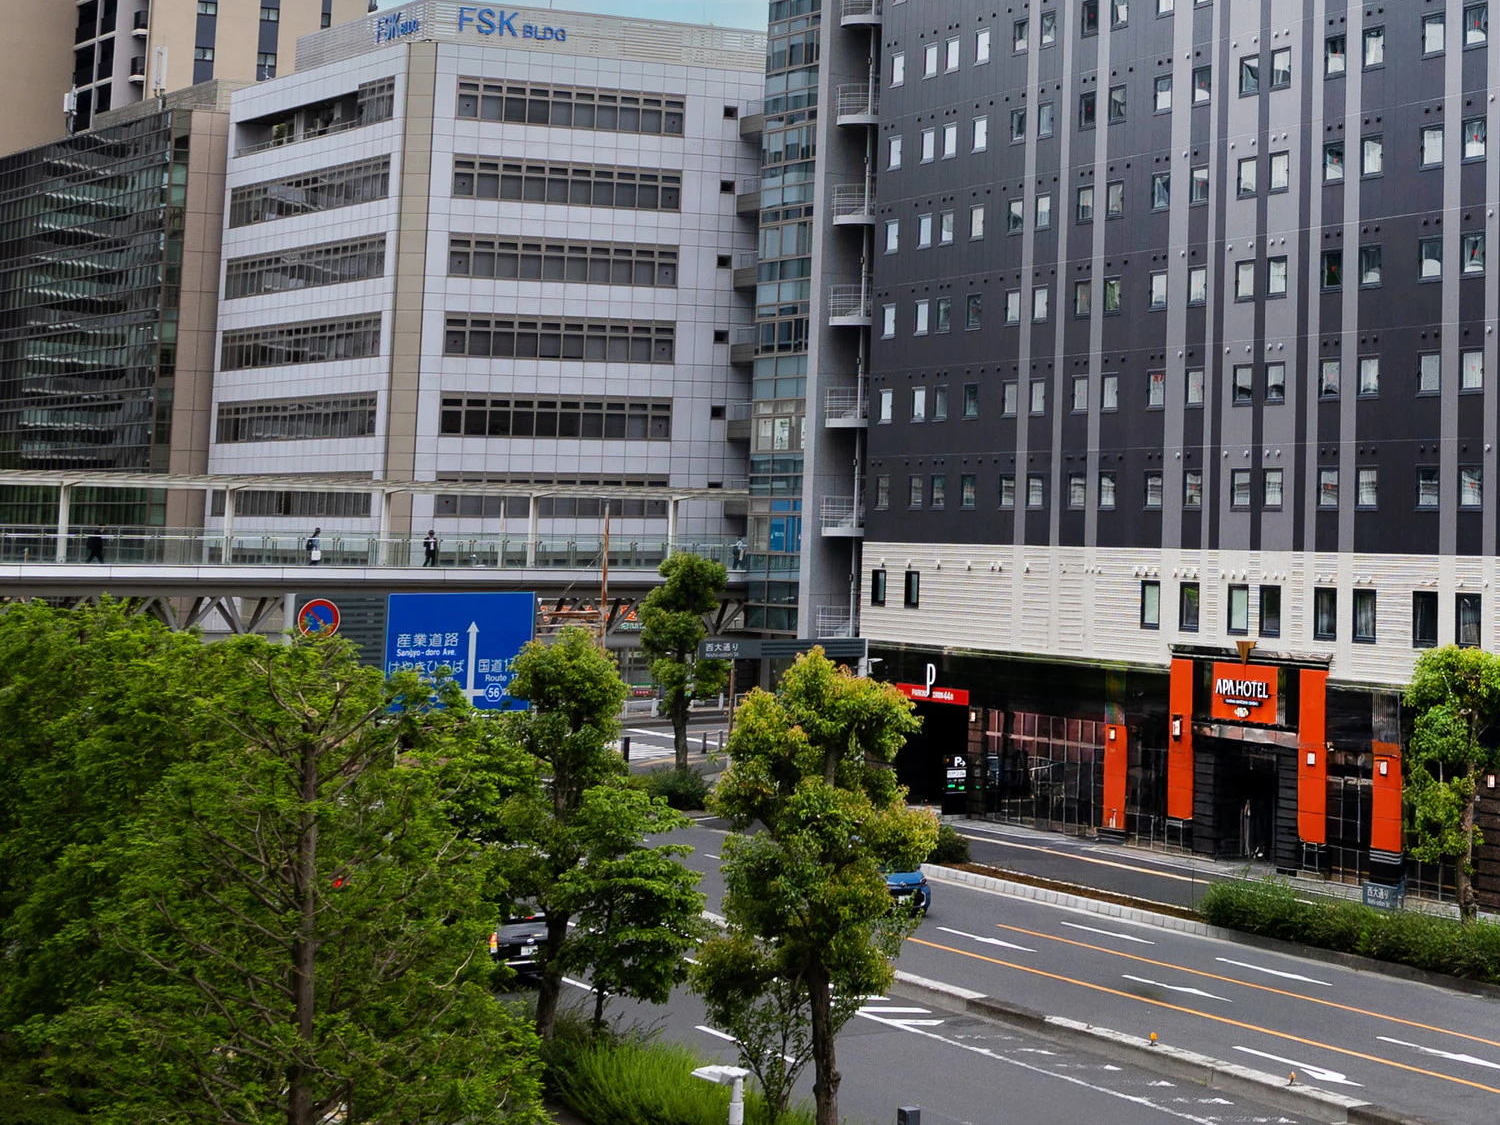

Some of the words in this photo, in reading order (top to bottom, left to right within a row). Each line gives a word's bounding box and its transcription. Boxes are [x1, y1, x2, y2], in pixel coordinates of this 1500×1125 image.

[376, 12, 401, 43] FSK
[457, 6, 518, 37] FSK
[523, 24, 567, 42] BLDG
[397, 633, 459, 648] 産業道路
[705, 642, 739, 652] 西大通り
[485, 673, 507, 682] Route
[926, 663, 936, 697] P
[488, 687, 500, 698] 56
[1215, 678, 1235, 695] APA
[1236, 679, 1269, 699] HOTEL
[954, 756, 963, 767] P
